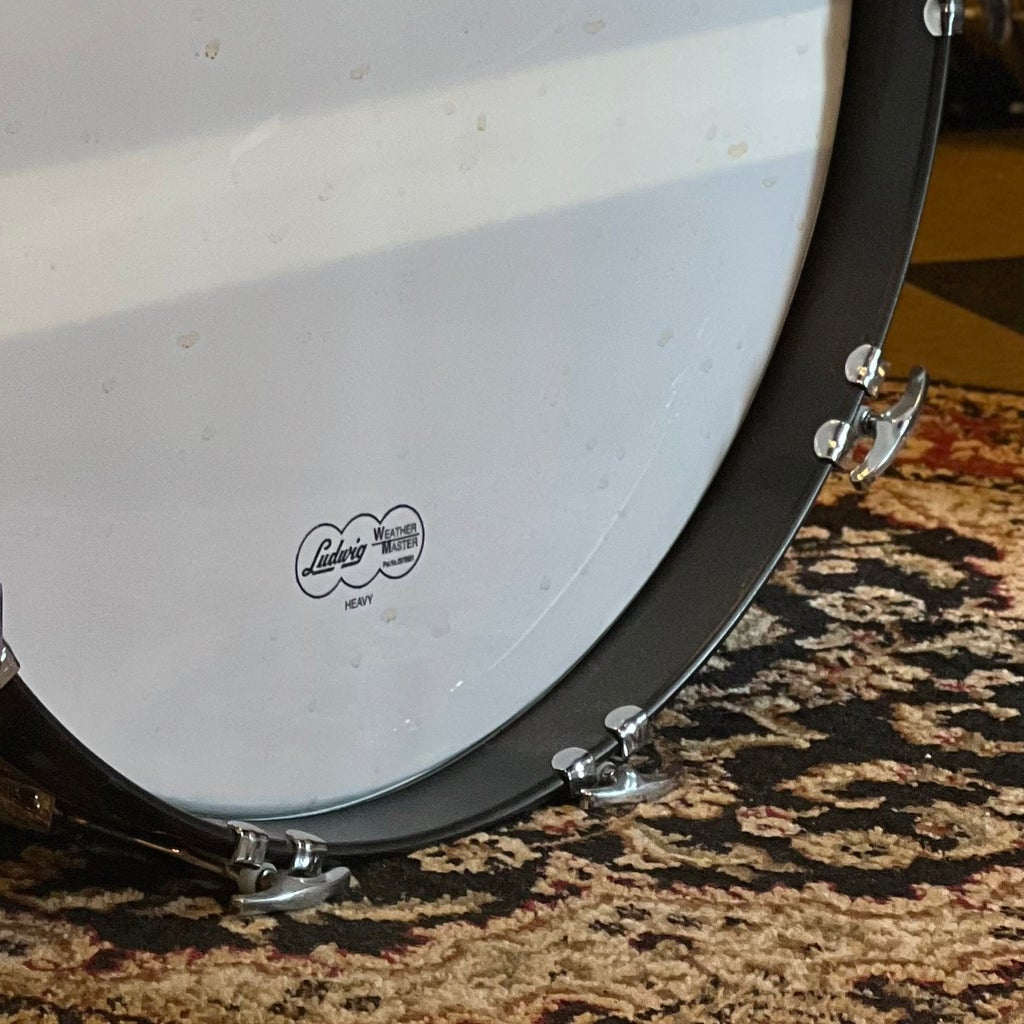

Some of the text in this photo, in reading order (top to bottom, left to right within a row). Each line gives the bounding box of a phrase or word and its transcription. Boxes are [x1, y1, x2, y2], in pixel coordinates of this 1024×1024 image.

[373, 523, 417, 541] WEATHER
[381, 537, 419, 554] MASTER
[301, 537, 368, 577] Ludwig
[344, 594, 374, 611] HEAVY
